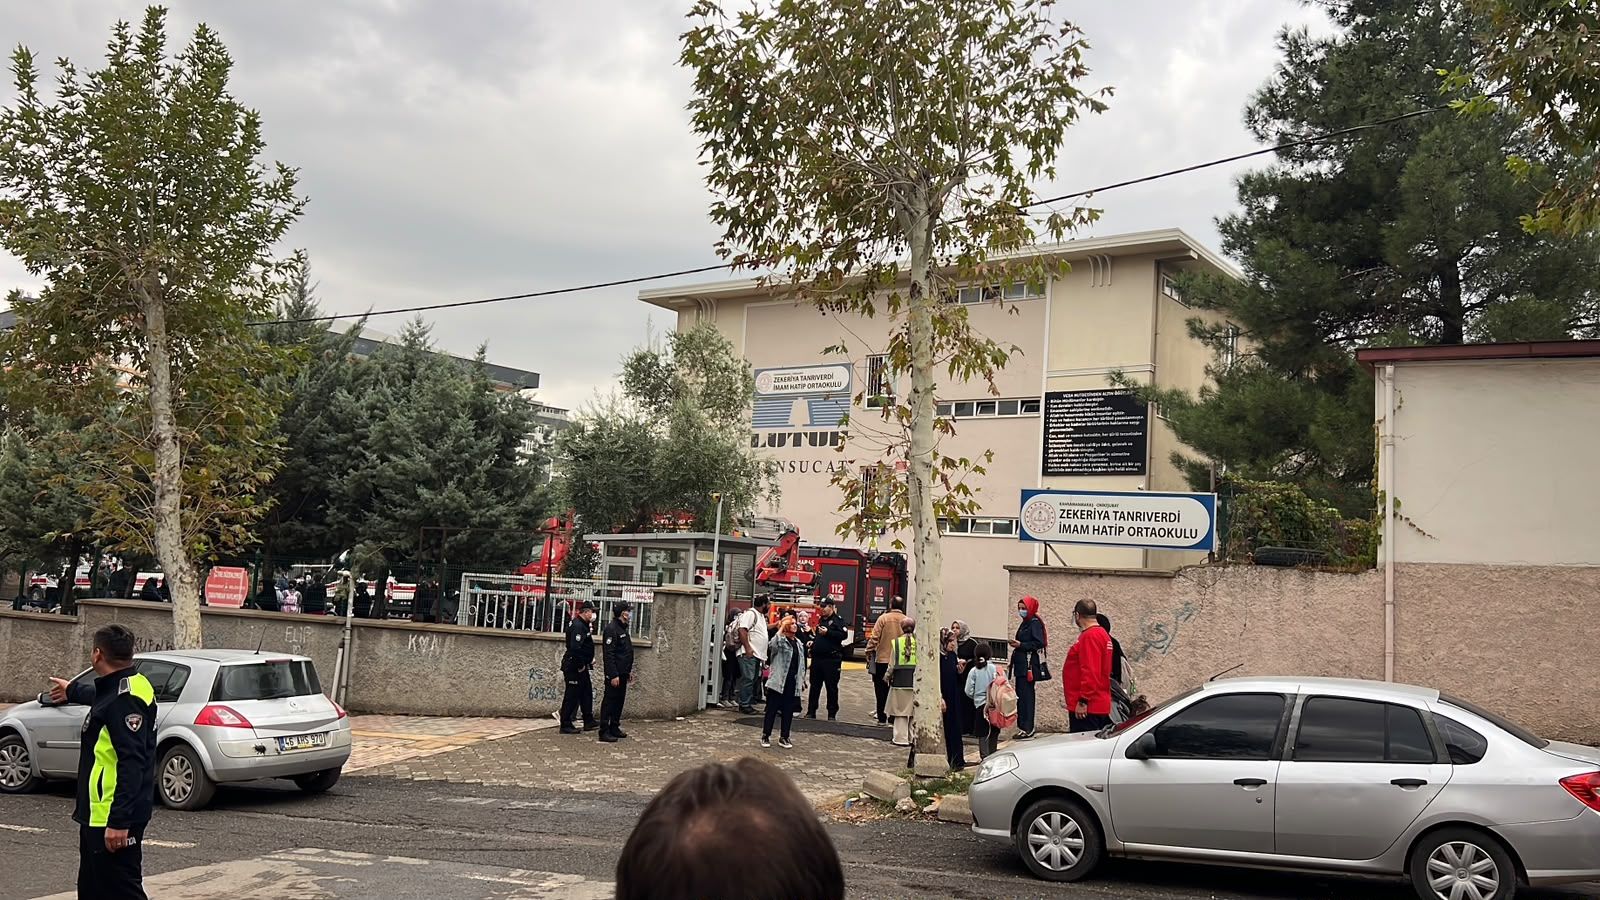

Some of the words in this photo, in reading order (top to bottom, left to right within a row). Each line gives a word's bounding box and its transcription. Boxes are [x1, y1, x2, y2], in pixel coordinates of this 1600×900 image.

[776, 460, 847, 473] NSUCAT
[1059, 508, 1111, 521] ZEKERİYA
[1113, 510, 1181, 523] TANRIVERDİ
[1058, 523, 1090, 535] İMAM
[1092, 524, 1125, 536] HATİP
[1127, 526, 1198, 539] ORTAOKULU
[831, 583, 843, 594] 112
